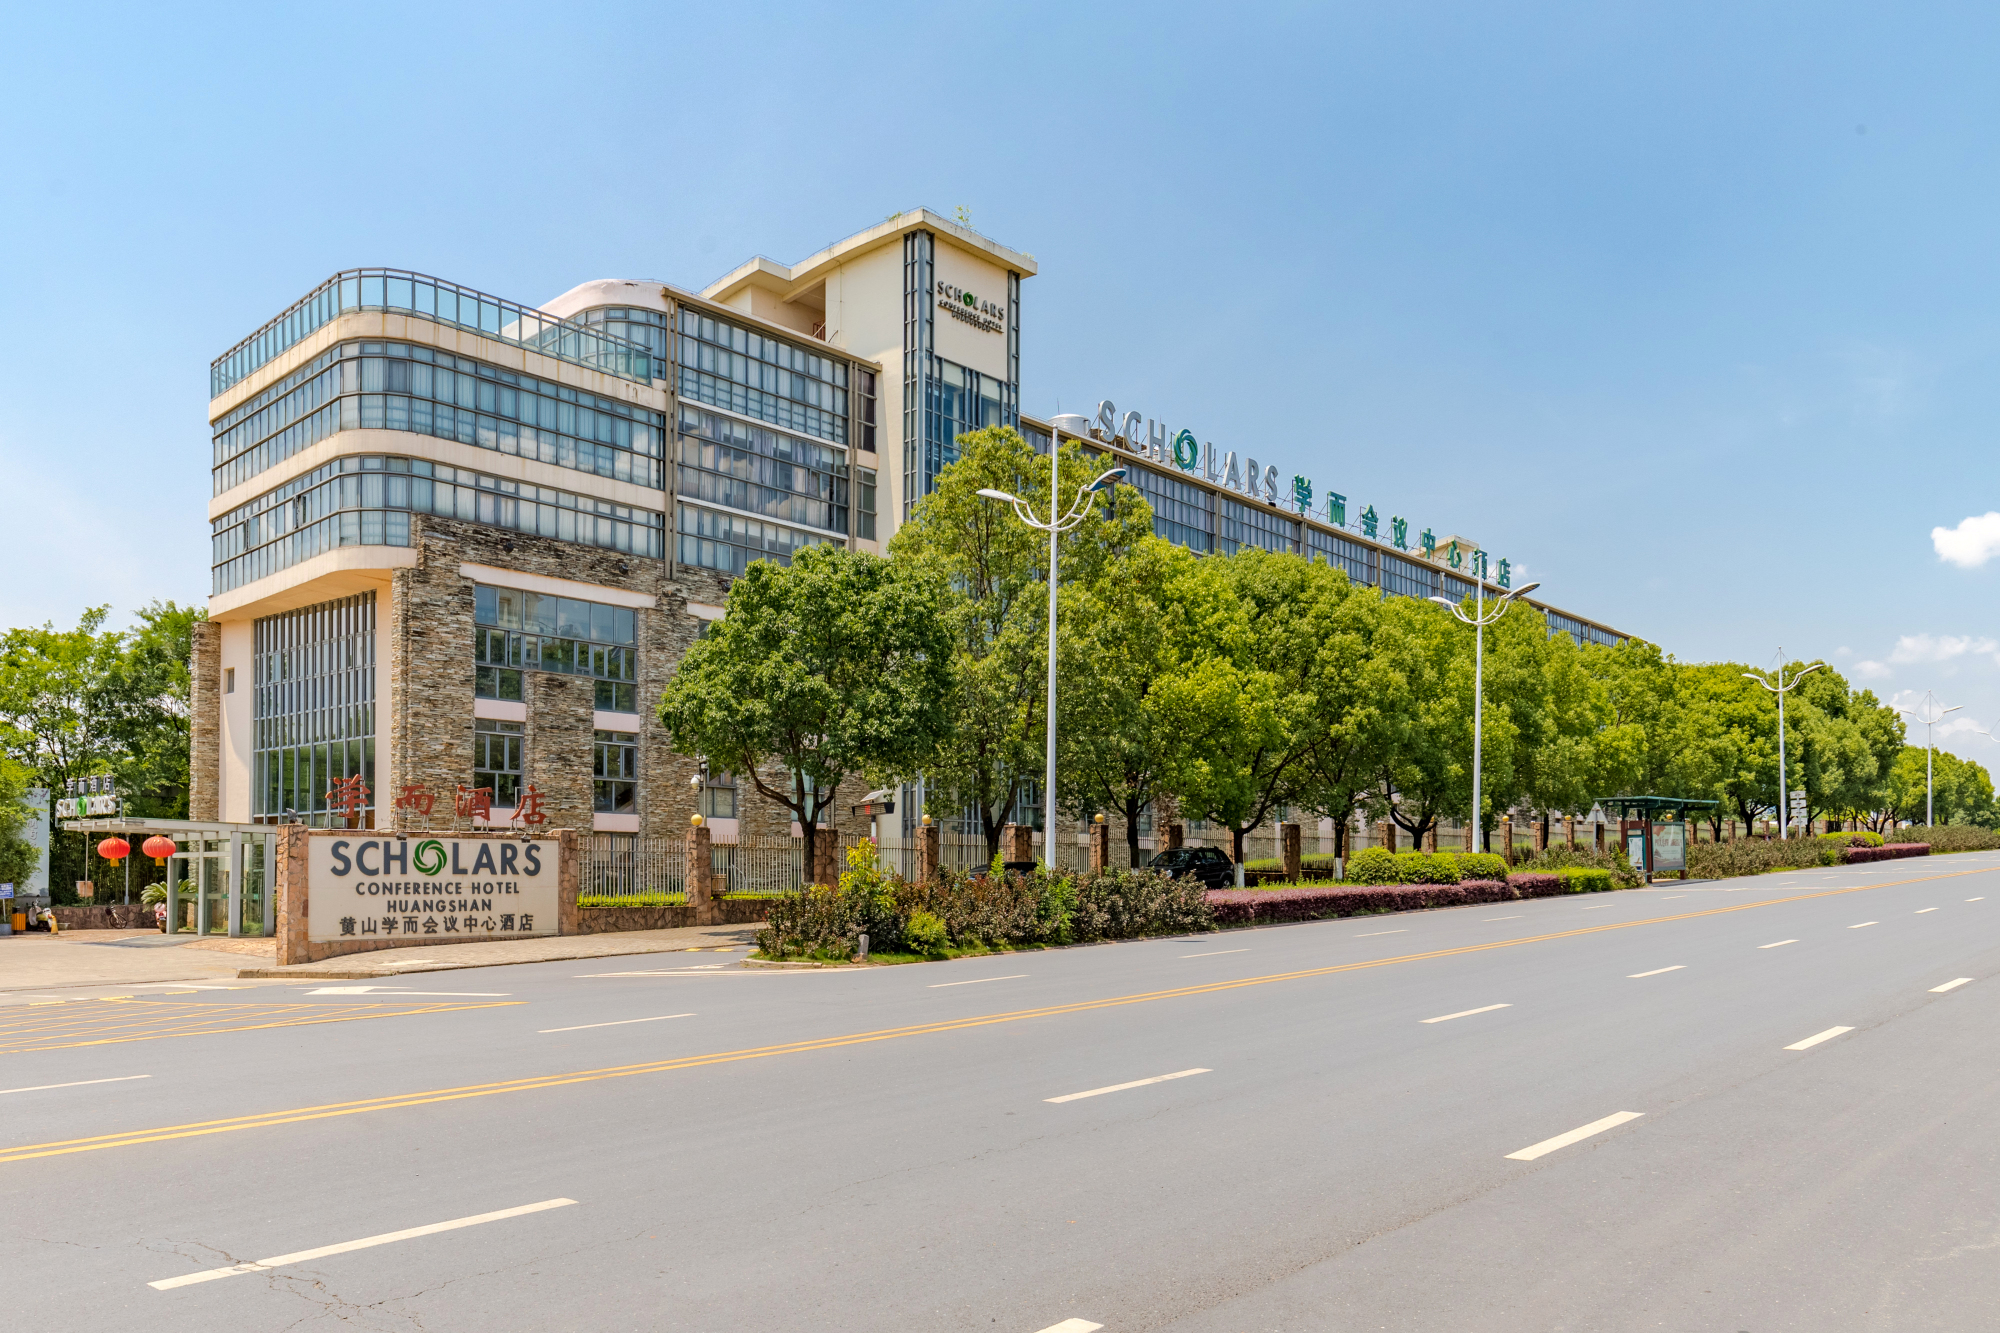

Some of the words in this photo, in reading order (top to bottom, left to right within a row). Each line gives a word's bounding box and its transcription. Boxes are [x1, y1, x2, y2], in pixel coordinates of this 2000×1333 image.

[937, 281, 1004, 321] SCHOLARS
[1100, 400, 1278, 501] SCHOLARS
[56, 794, 117, 818] SCHOLARS
[330, 840, 541, 876] SCHOLARS
[355, 881, 462, 896] CONFERENCE
[471, 881, 520, 895] HOTEL
[387, 899, 492, 914] HUANGSHAN
[339, 914, 534, 936] 黄山学而会议中心酒店
